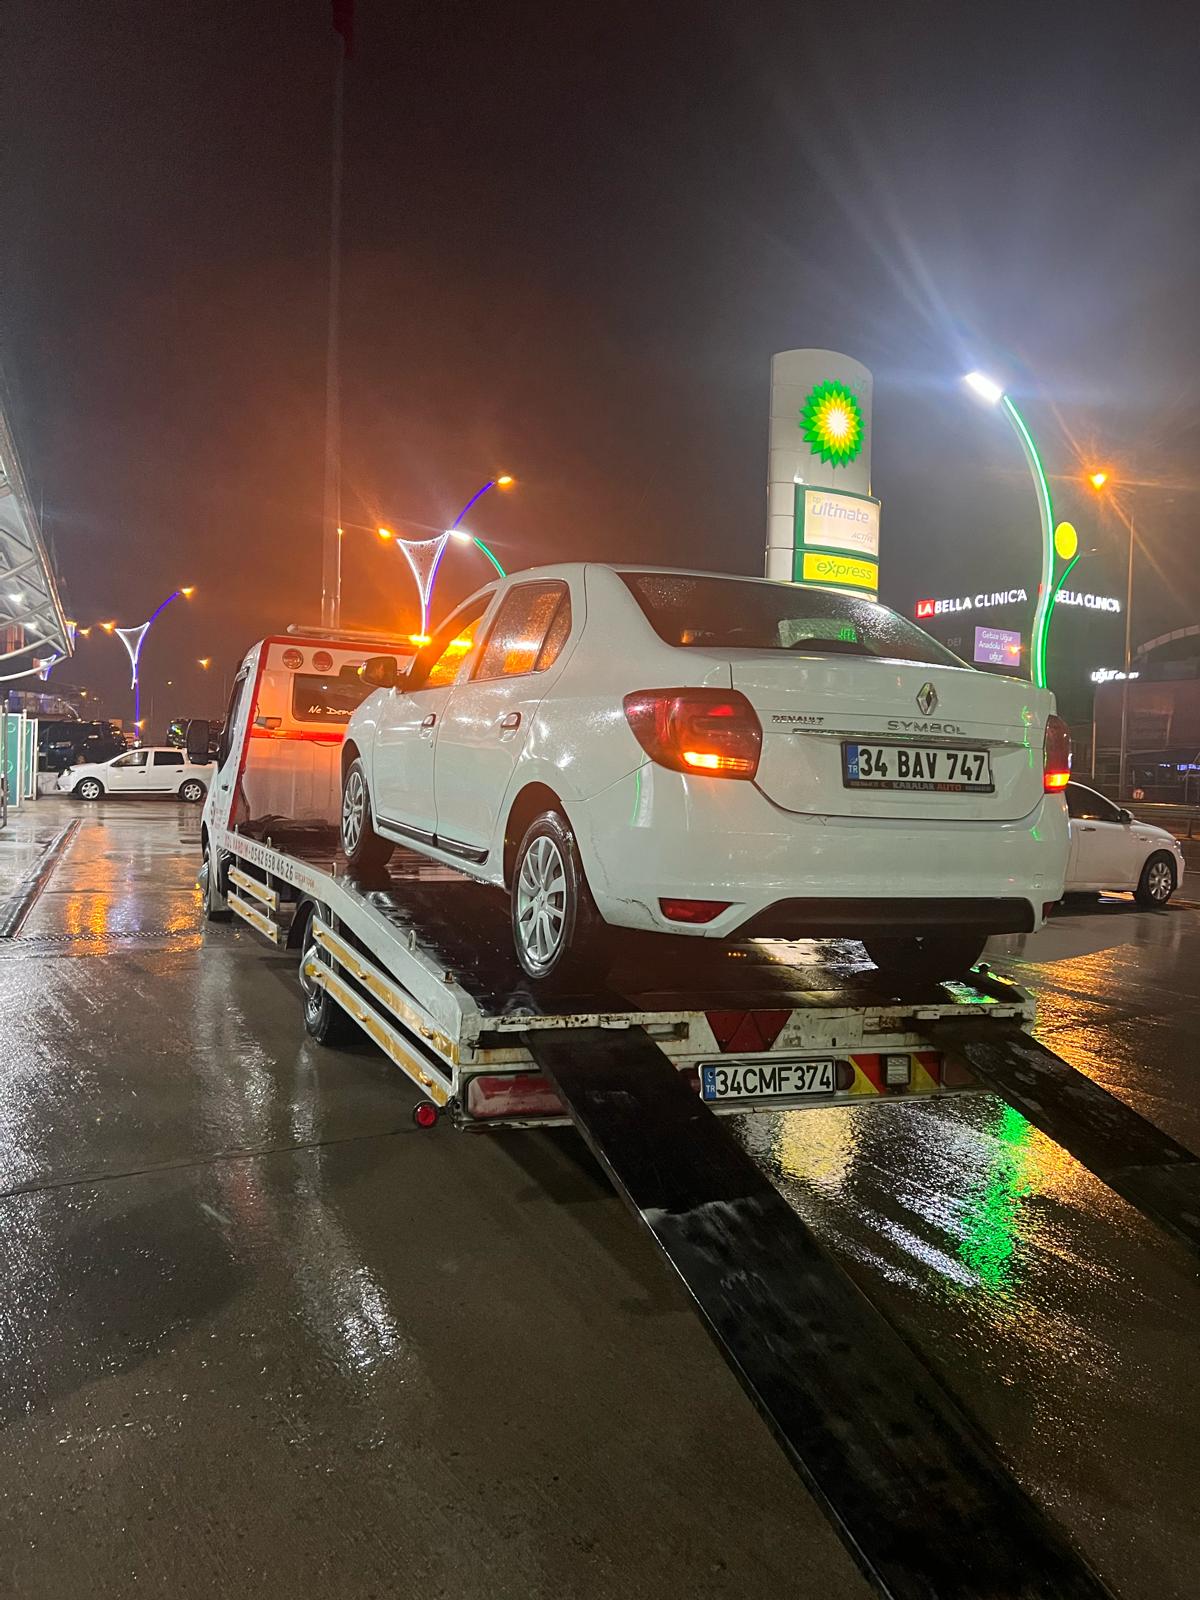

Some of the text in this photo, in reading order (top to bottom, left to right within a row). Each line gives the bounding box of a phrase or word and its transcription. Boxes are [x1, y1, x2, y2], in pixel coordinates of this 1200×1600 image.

[812, 502, 869, 524] ultimate
[917, 602, 933, 616] LA
[934, 597, 973, 614] BELLA
[307, 705, 322, 714] Ne
[772, 714, 825, 726] RENAULT
[887, 720, 967, 736] SYMBOL
[848, 764, 858, 774] TR
[859, 748, 985, 781] 34 BAV 747
[715, 1064, 832, 1096] 34CMF374
[705, 1084, 716, 1093] TR
